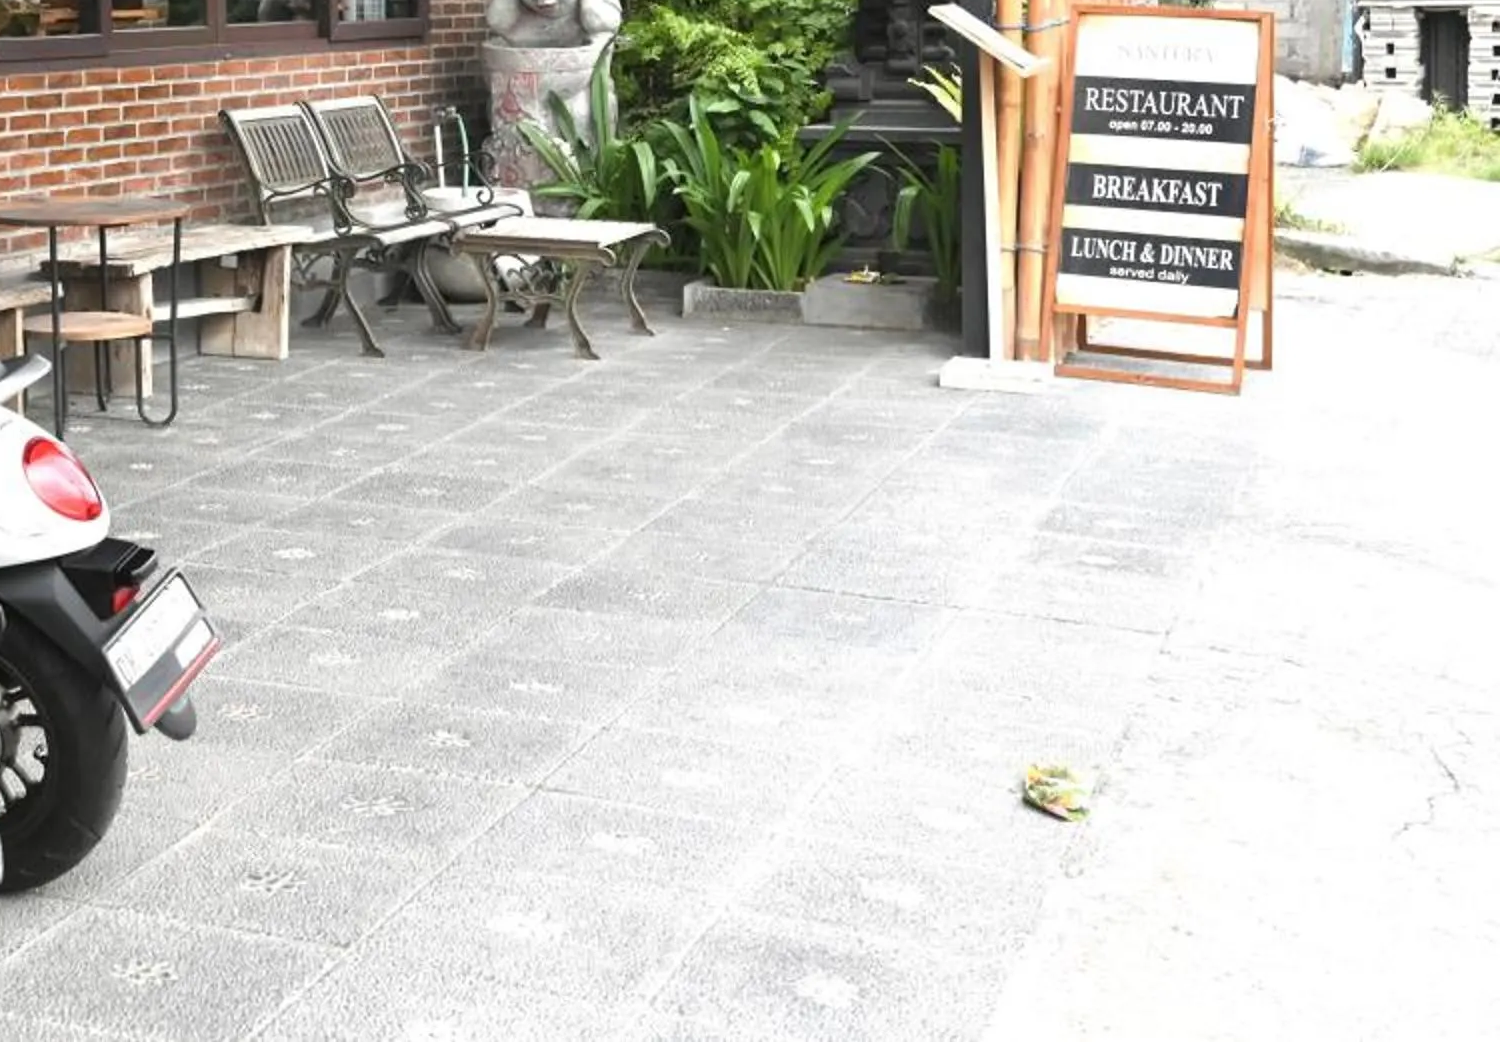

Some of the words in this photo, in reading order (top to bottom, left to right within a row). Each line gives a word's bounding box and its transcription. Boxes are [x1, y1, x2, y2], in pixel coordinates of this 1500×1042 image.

[1085, 87, 1245, 119] RESTAURANT
[1108, 120, 1138, 132] open
[1092, 174, 1223, 206] BREAKFAST
[1071, 235, 1137, 262] LUNCH
[1140, 242, 1155, 263] &
[1159, 244, 1234, 271] DINNER
[1109, 266, 1155, 279] served
[1157, 269, 1189, 285] daily
